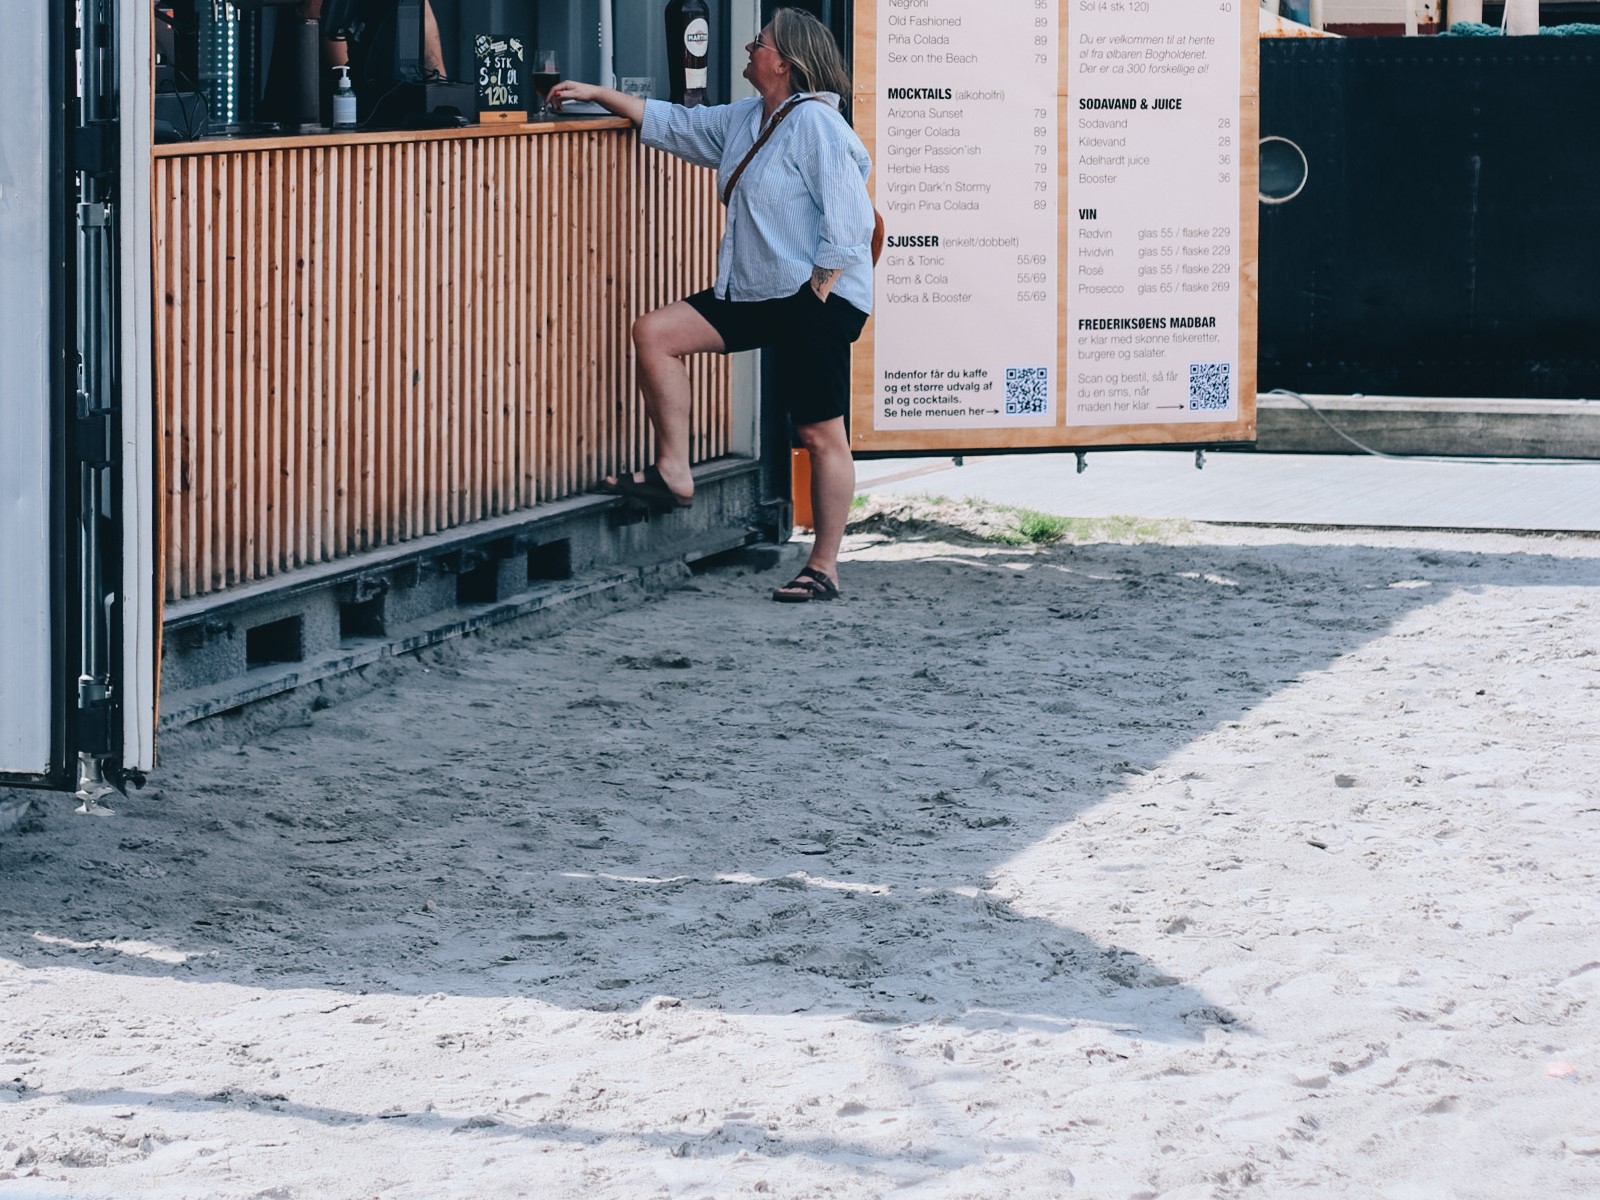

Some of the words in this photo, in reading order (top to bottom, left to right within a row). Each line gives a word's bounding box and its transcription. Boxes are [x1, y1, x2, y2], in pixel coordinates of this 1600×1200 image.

[1034, 0, 1047, 9] 95
[1080, 1, 1095, 11] Sol
[1110, 1, 1125, 11] stk
[1220, 3, 1231, 12] 40
[889, 15, 906, 26] Old
[910, 16, 961, 26] Fashioned
[1035, 17, 1048, 27] 89
[914, 34, 949, 45] Colada
[1035, 35, 1047, 46] 89
[888, 52, 907, 63] Sex
[911, 55, 923, 63] on
[927, 53, 943, 63] the
[946, 53, 977, 63] Beach
[1035, 54, 1047, 64] 79
[1079, 49, 1089, 59] øl
[1091, 48, 1103, 59] fra
[1106, 49, 1142, 59] ølbaren
[484, 56, 491, 67] 4
[494, 57, 512, 68] STK
[507, 69, 519, 85] ØL
[485, 86, 507, 106] 120
[508, 95, 519, 104] KR
[888, 88, 952, 100] MOCKTAILS
[955, 89, 1005, 102] (alkoholfri)
[1079, 98, 1136, 110] SODAVAND
[1152, 98, 1182, 110] JUICE
[888, 108, 926, 118] Arizona
[929, 107, 963, 118] Sunset
[1034, 108, 1046, 119] 79
[1079, 118, 1127, 128] Sodavand
[1218, 118, 1231, 128] 28
[888, 126, 921, 139] Ginger
[924, 126, 960, 137] Colada
[1034, 127, 1046, 137] 89
[1079, 137, 1125, 147] Kildevand
[1218, 136, 1231, 147] 28
[888, 144, 921, 158] Ginger
[1035, 145, 1046, 155] 79
[1079, 155, 1124, 167] Adelhardt
[1128, 157, 1149, 167] juice
[1218, 154, 1231, 165] 36
[888, 163, 921, 174] Herbie
[924, 163, 949, 174] Hass
[1035, 163, 1047, 173] 79
[1079, 173, 1116, 183] Booster
[1219, 173, 1231, 183] 36
[887, 182, 916, 195] Virgin
[955, 181, 991, 194] Stormy
[1035, 181, 1047, 191] 79
[887, 200, 915, 213] Virgin
[944, 200, 979, 211] Colada
[1034, 200, 1046, 210] 89
[1079, 209, 1096, 220] VIN
[1079, 228, 1112, 239] Rødvin
[1138, 228, 1158, 241] glas
[1161, 228, 1173, 238] 55
[1183, 227, 1209, 238] flaske
[1212, 227, 1231, 238] 229
[887, 236, 939, 247] SJUSSER
[943, 237, 1019, 249] (enkelt/dobbelt)
[887, 256, 904, 266] Gin
[918, 255, 944, 266] Tonic
[1017, 255, 1046, 265] 55/69
[887, 274, 911, 285] Rom
[925, 274, 948, 285] Cola
[1018, 272, 1046, 283] 55/69
[887, 293, 919, 303] Vodka
[932, 292, 971, 303] Booster
[1017, 290, 1046, 302] 55/69
[1079, 318, 1166, 330] FREDERIKSØENS
[1170, 317, 1215, 328] MADBAR
[885, 370, 927, 379] Indenfor
[931, 369, 944, 378] får
[947, 370, 960, 378] du
[963, 369, 987, 378] kaffe
[1078, 373, 1103, 384] Scan
[1106, 375, 1118, 385] og
[1152, 371, 1163, 382] så
[1166, 371, 1178, 381] får
[884, 385, 897, 394] og
[901, 384, 910, 392] et
[914, 383, 944, 392] større
[947, 382, 980, 392] udvalg
[983, 381, 992, 390] af
[884, 396, 893, 405] øl
[897, 398, 910, 407] og
[913, 395, 961, 404] cocktails.
[1078, 401, 1111, 412] maden
[1114, 401, 1130, 411] her
[1133, 400, 1151, 410] klar.
[884, 408, 897, 417] Se
[901, 406, 922, 417] hele
[969, 407, 985, 416] her
